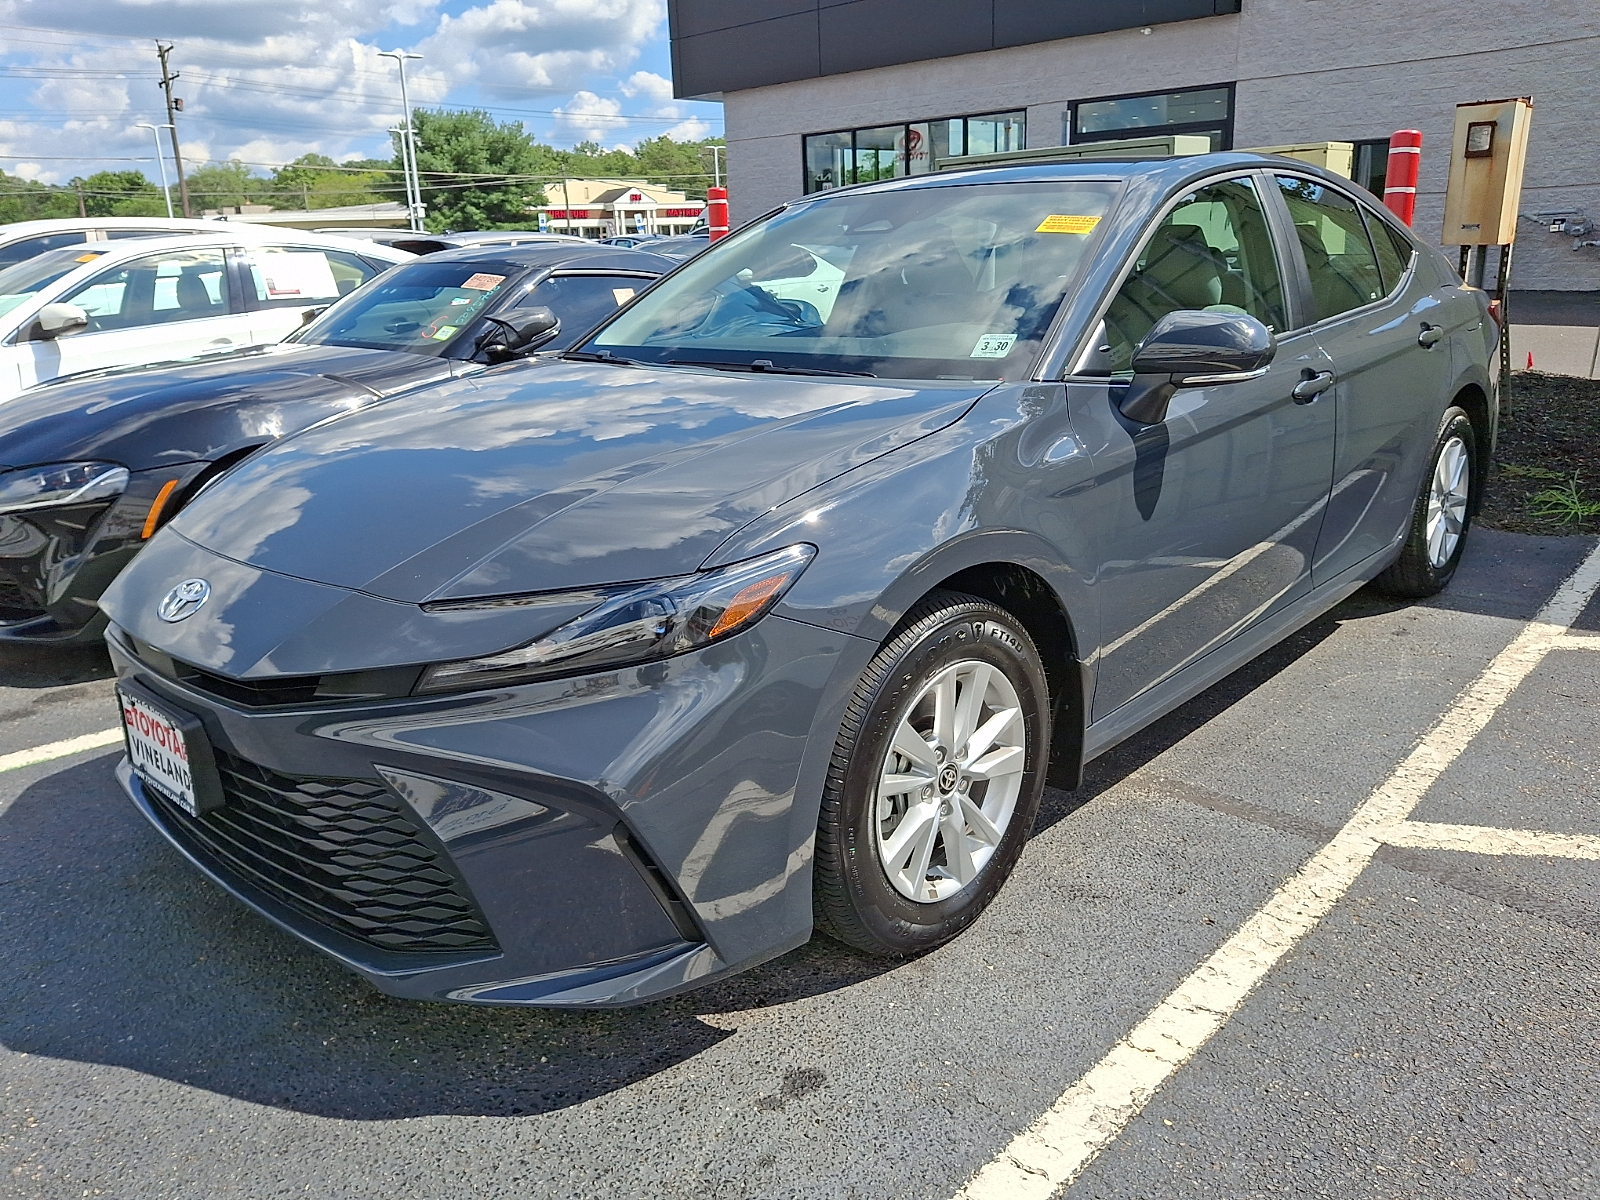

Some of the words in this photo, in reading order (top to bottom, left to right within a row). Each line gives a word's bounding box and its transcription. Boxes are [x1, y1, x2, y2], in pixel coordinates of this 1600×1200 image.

[545, 209, 589, 218] URNTURE
[981, 341, 990, 351] 3
[994, 341, 1009, 351] 30
[131, 706, 184, 757] TOYOTA
[132, 735, 191, 790] VINELAND
